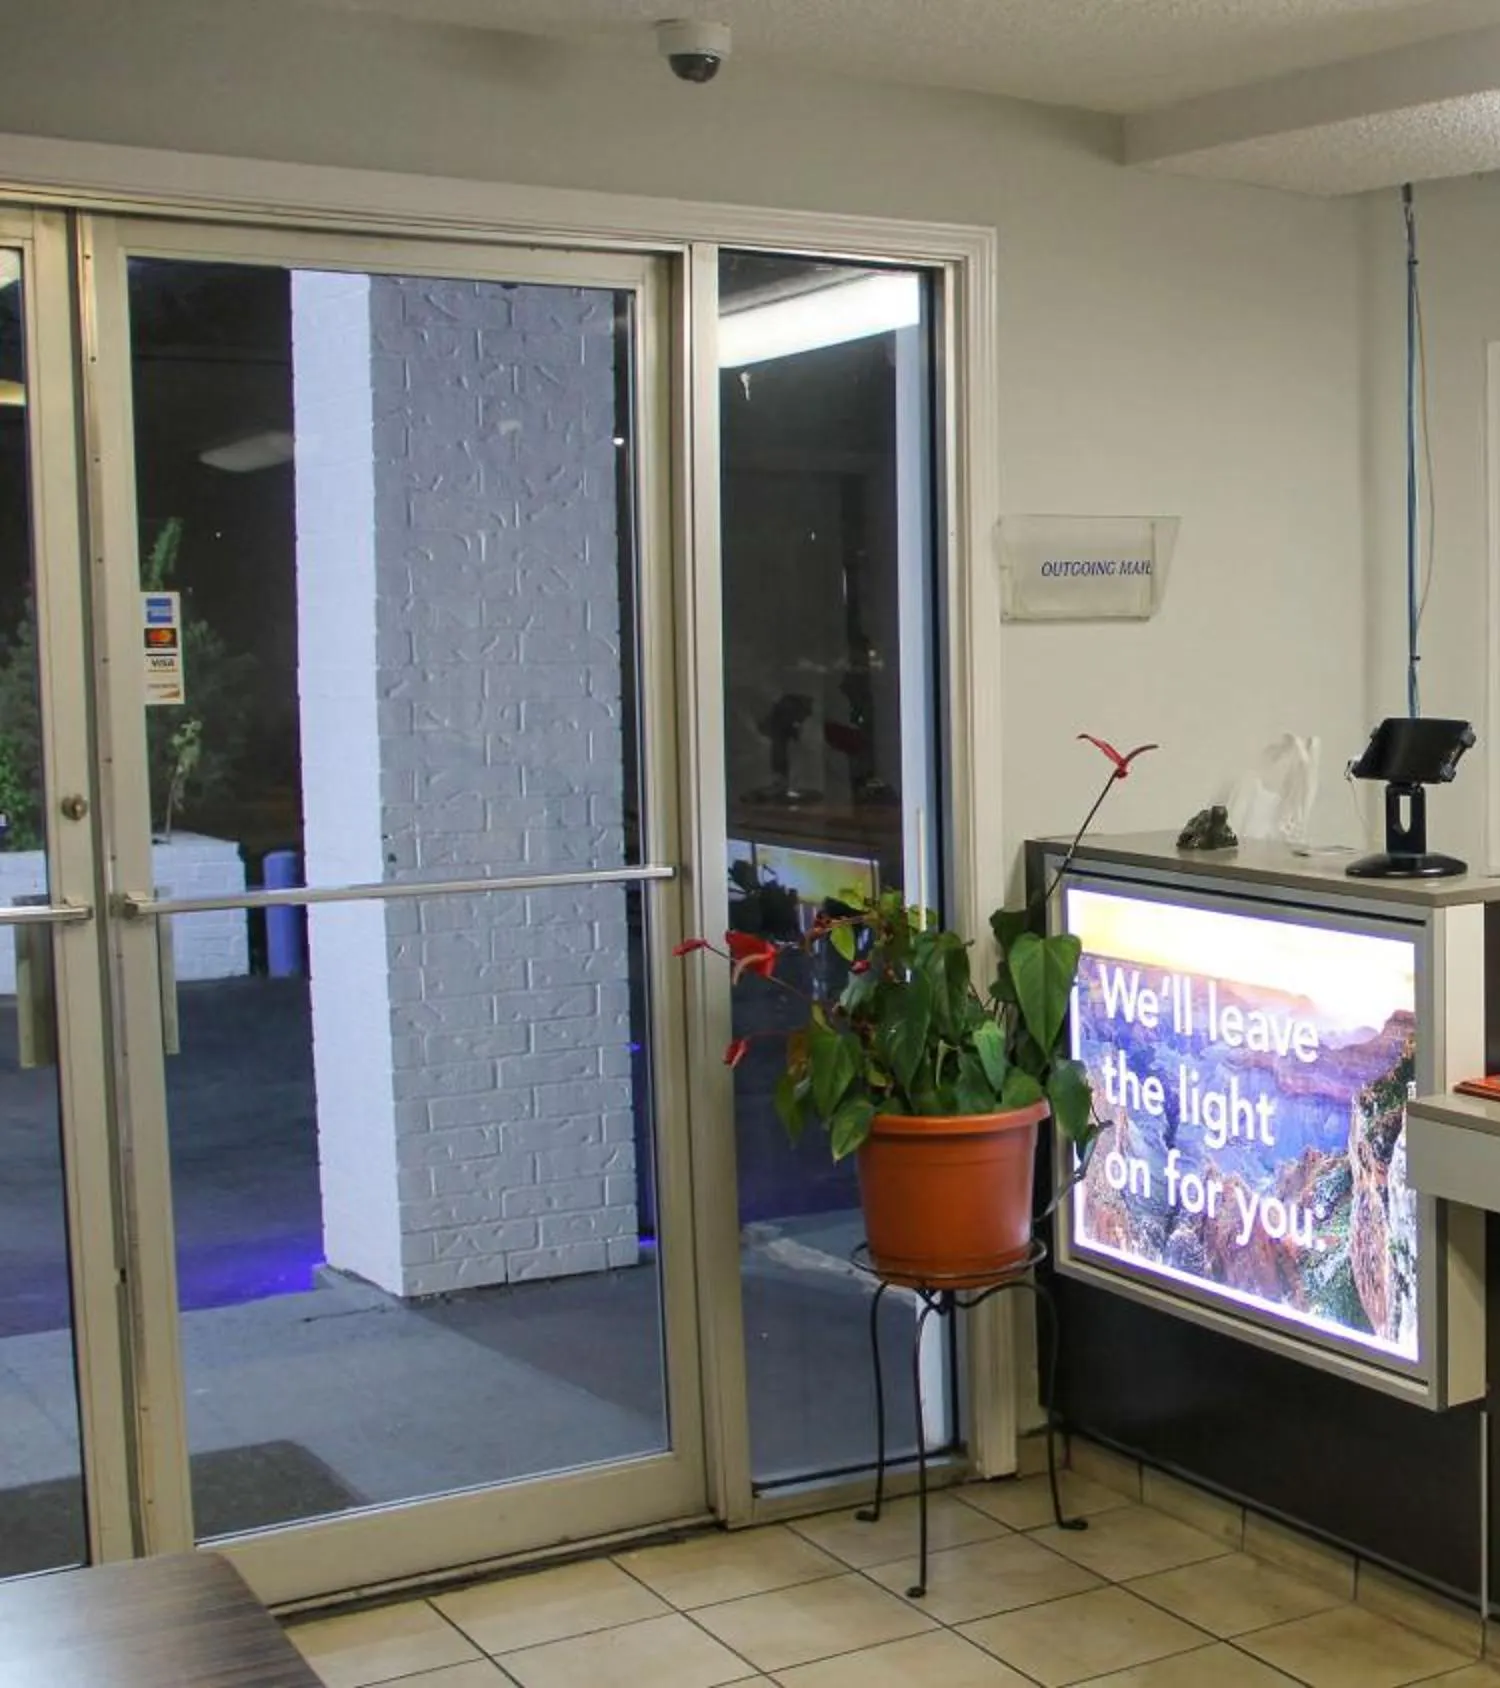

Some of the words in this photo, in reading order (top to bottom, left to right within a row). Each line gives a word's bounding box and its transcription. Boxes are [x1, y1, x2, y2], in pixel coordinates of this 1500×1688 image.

[1041, 560, 1116, 577] OUTGOING
[1119, 560, 1152, 576] MAIL
[1098, 963, 1193, 1036] We'll
[1208, 981, 1320, 1063] leave
[1103, 1050, 1165, 1114] the
[1178, 1064, 1276, 1150] light
[1104, 1151, 1152, 1199] on
[1163, 1149, 1222, 1220] for
